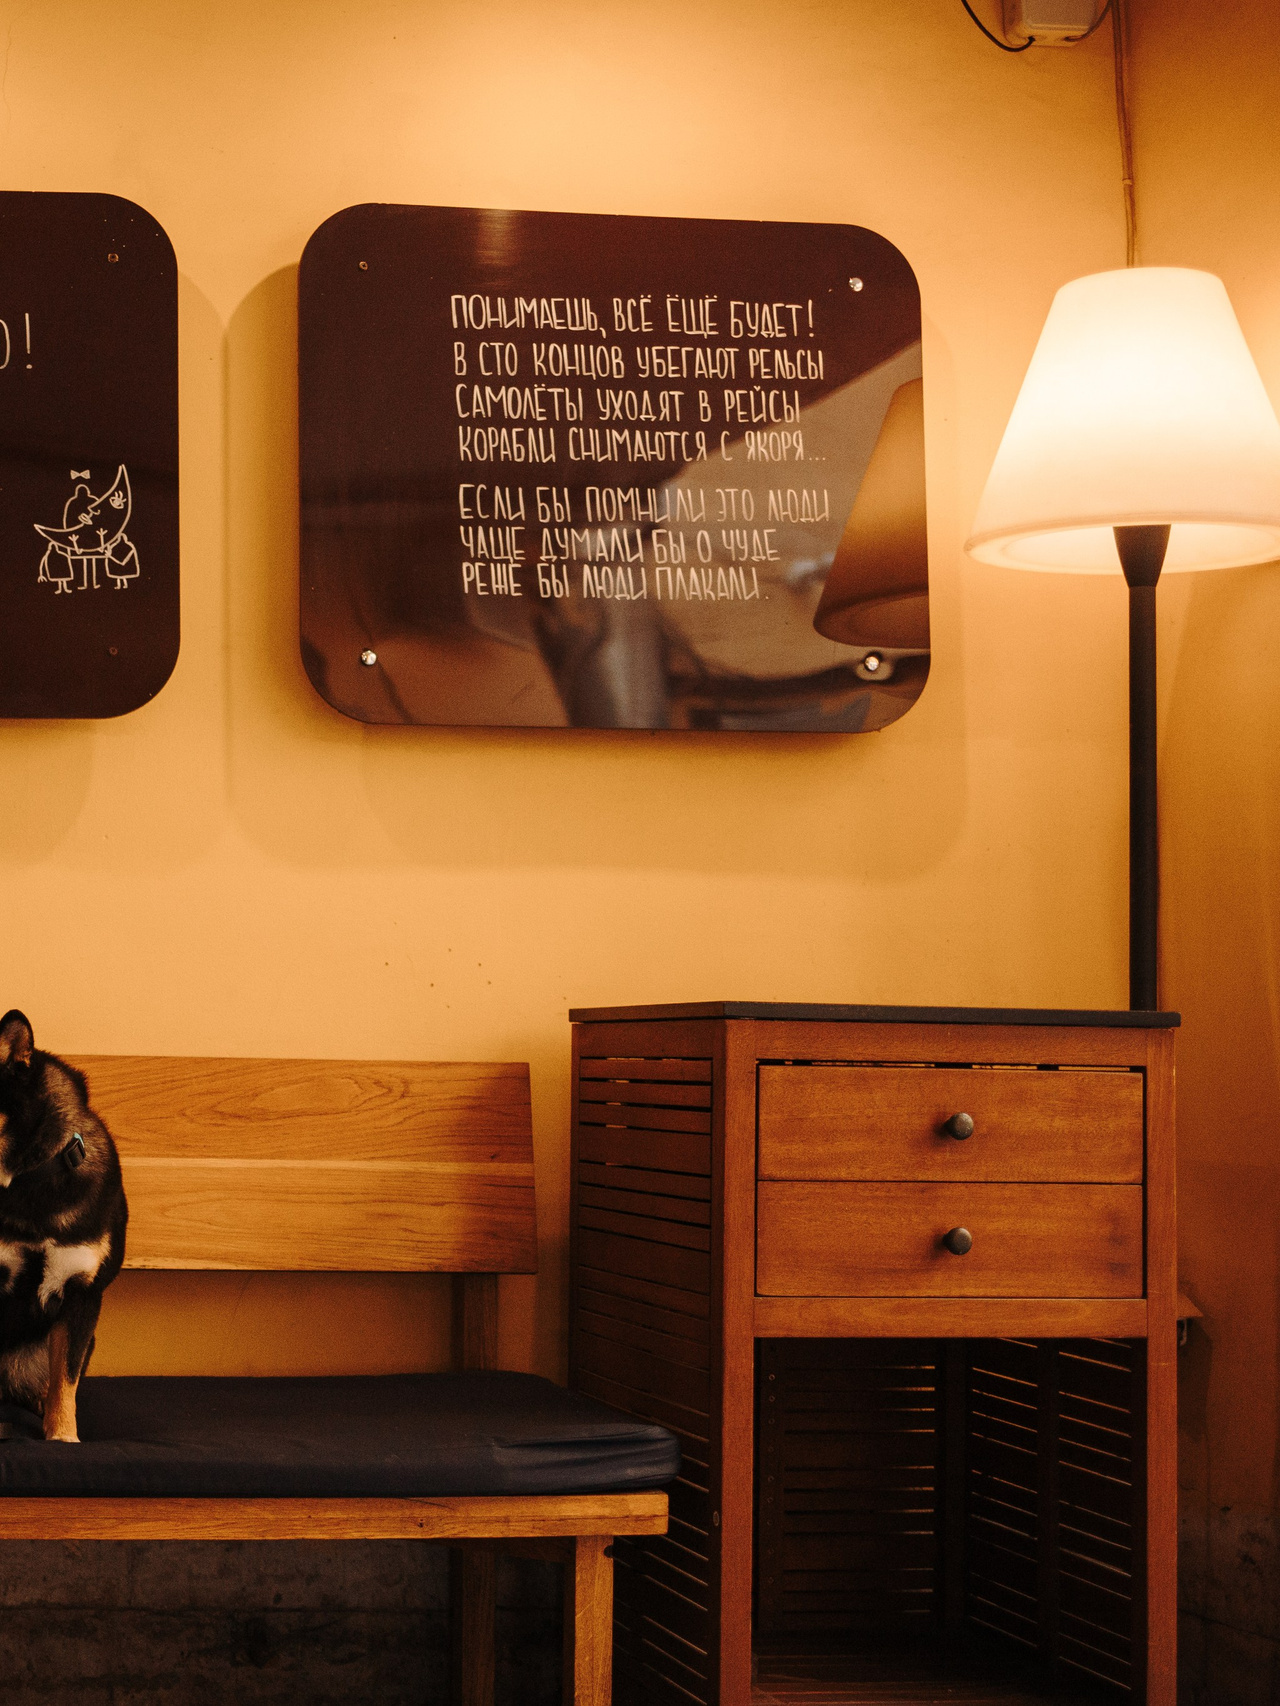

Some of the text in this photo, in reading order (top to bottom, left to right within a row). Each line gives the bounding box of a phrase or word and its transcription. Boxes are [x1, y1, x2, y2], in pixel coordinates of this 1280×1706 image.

[450, 293, 607, 339] ПОНИМАЕШЬ,
[612, 294, 654, 332] ВСЁ
[729, 299, 815, 339] БУДЕТ!
[453, 341, 824, 381] В СТО КОНЦОВ УБЕГАЮТ РЕЛЬСЫ
[455, 383, 801, 423] САМОЛЁТЫ УХОДЯТ В РЕЙСЫ
[458, 425, 556, 463] КОРАБЛИ
[568, 427, 708, 463] СНИМАЮТСЯ
[720, 430, 733, 461] С
[458, 483, 829, 523] ЕСЛИ БЫ ПОМНИЛИ ЭТО ЛЮДИ
[460, 525, 781, 564] ЧАЩЕ ДУМАЛИ БЫ О ЧУДЕ
[462, 561, 770, 601] РЕЖЕ БЫ ЛЮДИ ПЛАКАЛИ.
